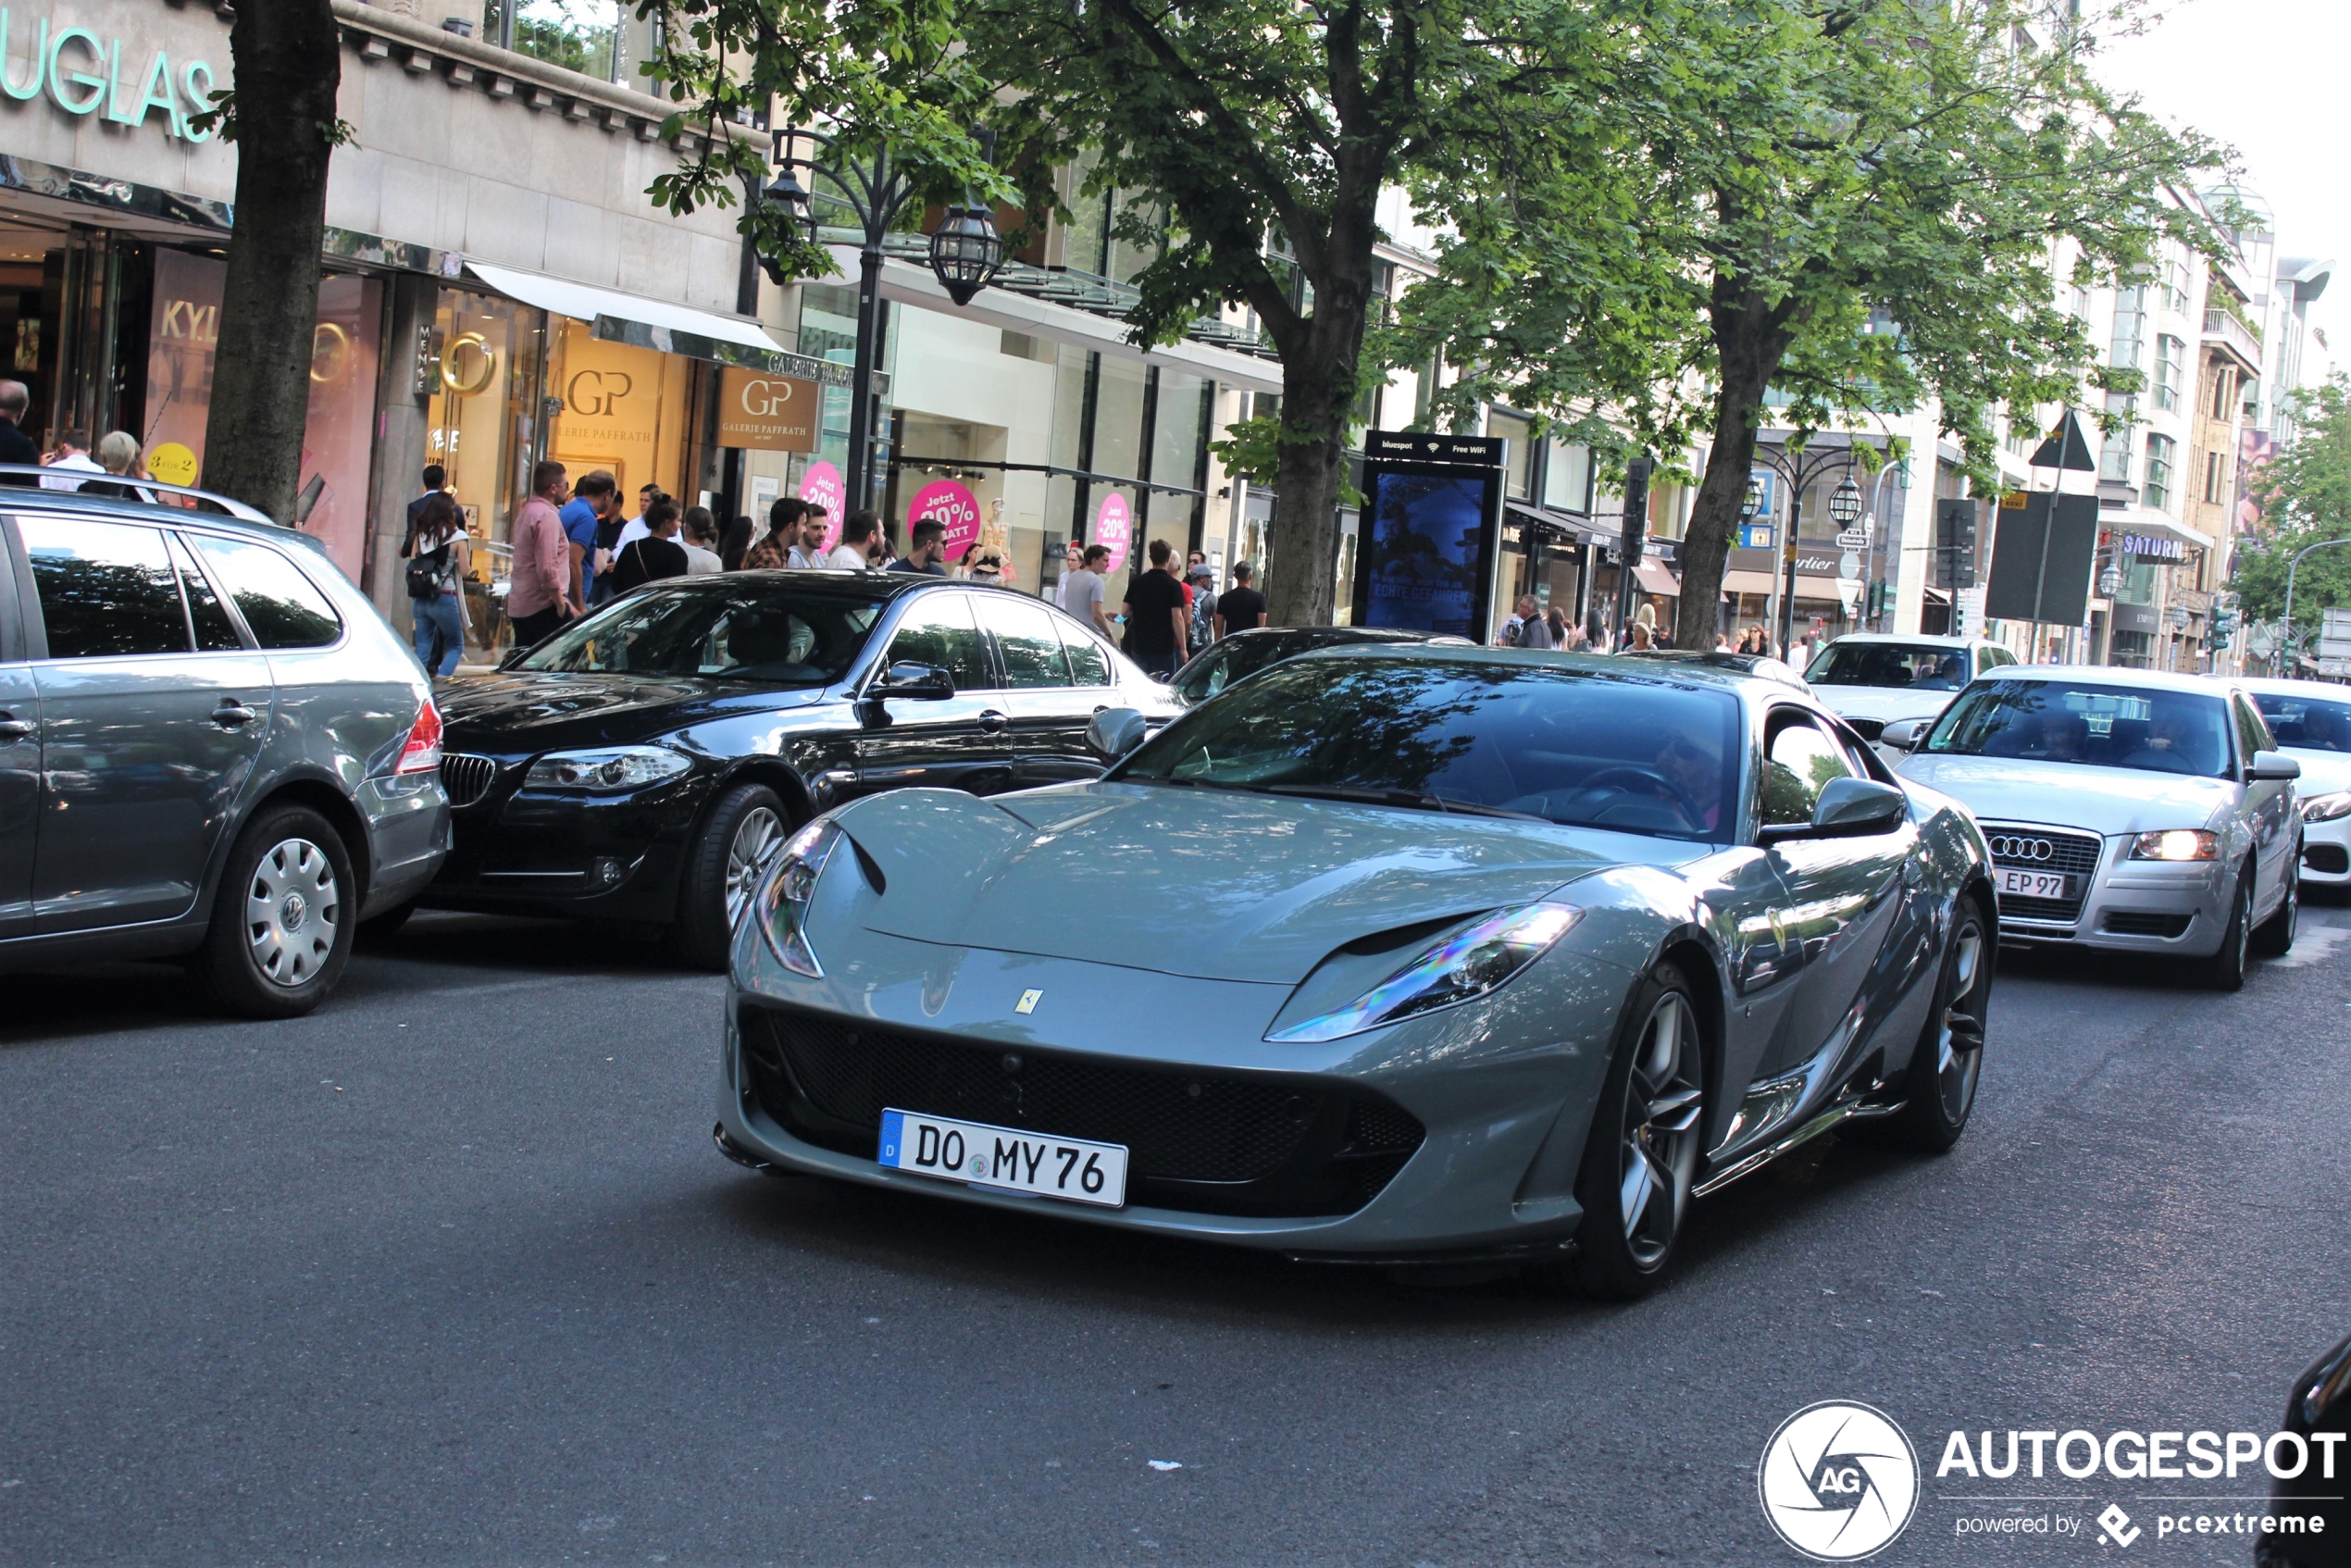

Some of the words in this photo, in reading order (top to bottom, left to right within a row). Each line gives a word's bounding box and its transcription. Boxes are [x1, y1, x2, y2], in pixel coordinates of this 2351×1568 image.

[768, 354, 818, 379] GALERIE
[567, 369, 633, 417] GP
[741, 380, 792, 417] GP
[592, 429, 651, 442] PAFFRATH
[722, 423, 760, 433] GALERIE
[761, 424, 807, 436] PAFFRATH
[1382, 441, 1412, 451] bluespot
[1452, 445, 1468, 454] Free
[1470, 446, 1486, 454] WiFi
[151, 456, 161, 467] 3
[162, 461, 179, 470] FÜR
[181, 459, 193, 472] 2
[816, 476, 835, 492] Jetzt
[927, 492, 955, 507] Jetzt
[1108, 506, 1122, 516] Jetzt
[1100, 518, 1127, 540] -20%
[2123, 535, 2183, 558] SATURN
[1375, 584, 1408, 599] ECHTE
[1412, 587, 1468, 604] GEFAHREN
[2006, 873, 2032, 891] EP
[2037, 877, 2060, 895] 97
[886, 1145, 894, 1156] D
[915, 1124, 964, 1171] DO
[992, 1137, 1046, 1184] MY
[1056, 1147, 1104, 1193] 76
